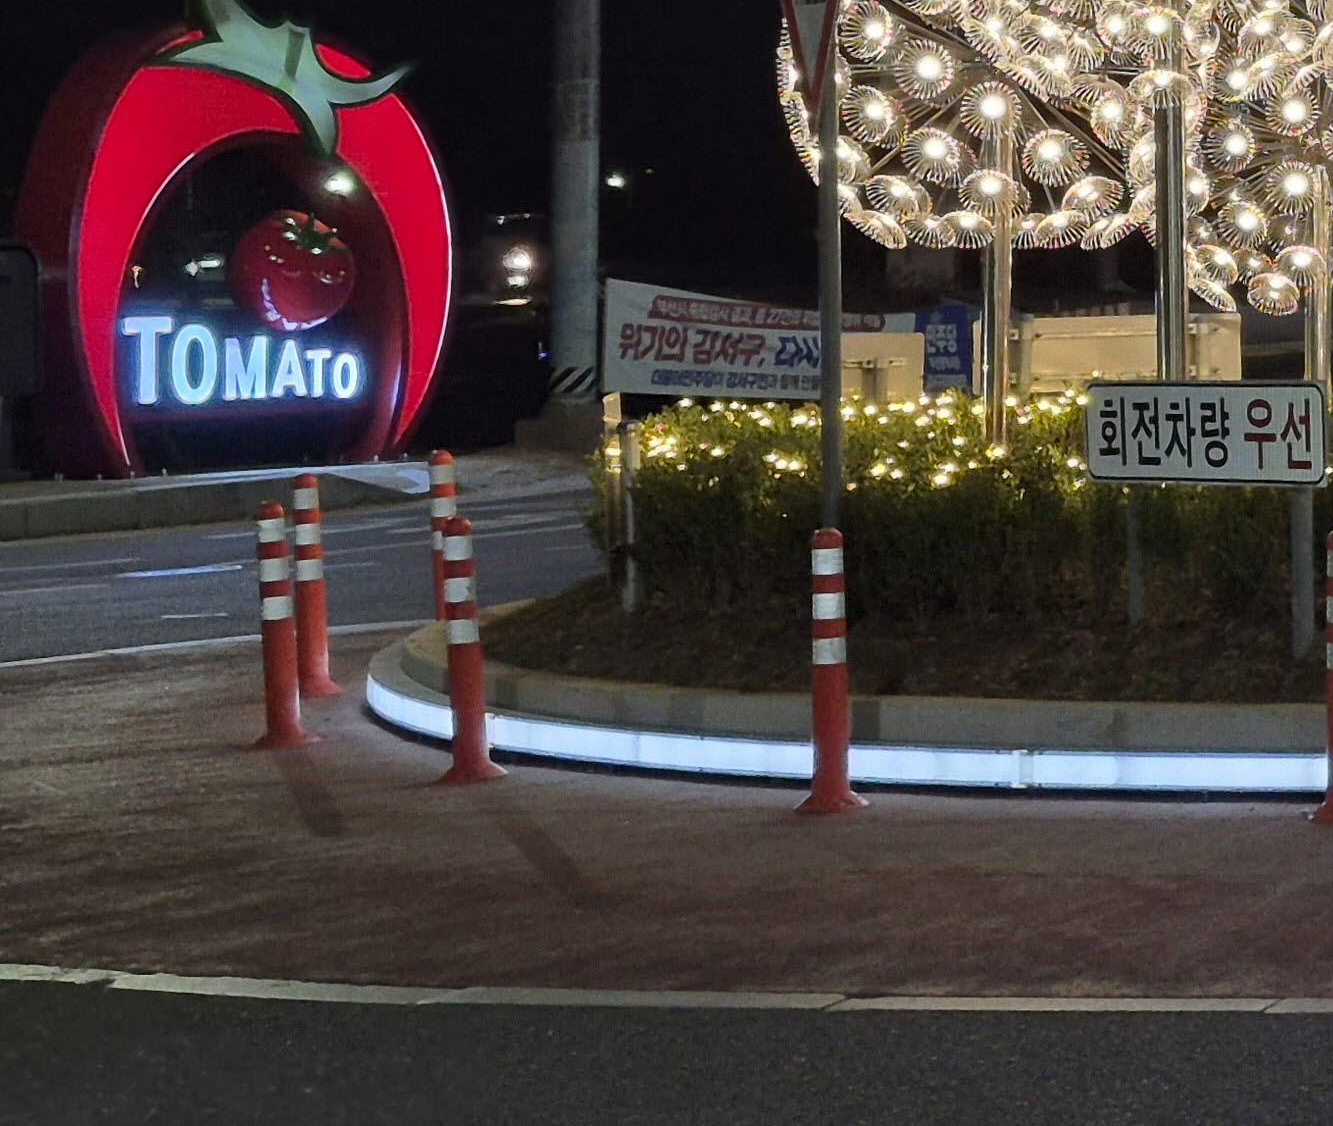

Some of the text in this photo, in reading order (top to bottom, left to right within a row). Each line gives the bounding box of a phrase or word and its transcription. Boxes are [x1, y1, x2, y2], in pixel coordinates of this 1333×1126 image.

[123, 316, 359, 405] TOMATO
[619, 323, 689, 362] 위기의
[1099, 396, 1312, 470] 회전차량 우선
